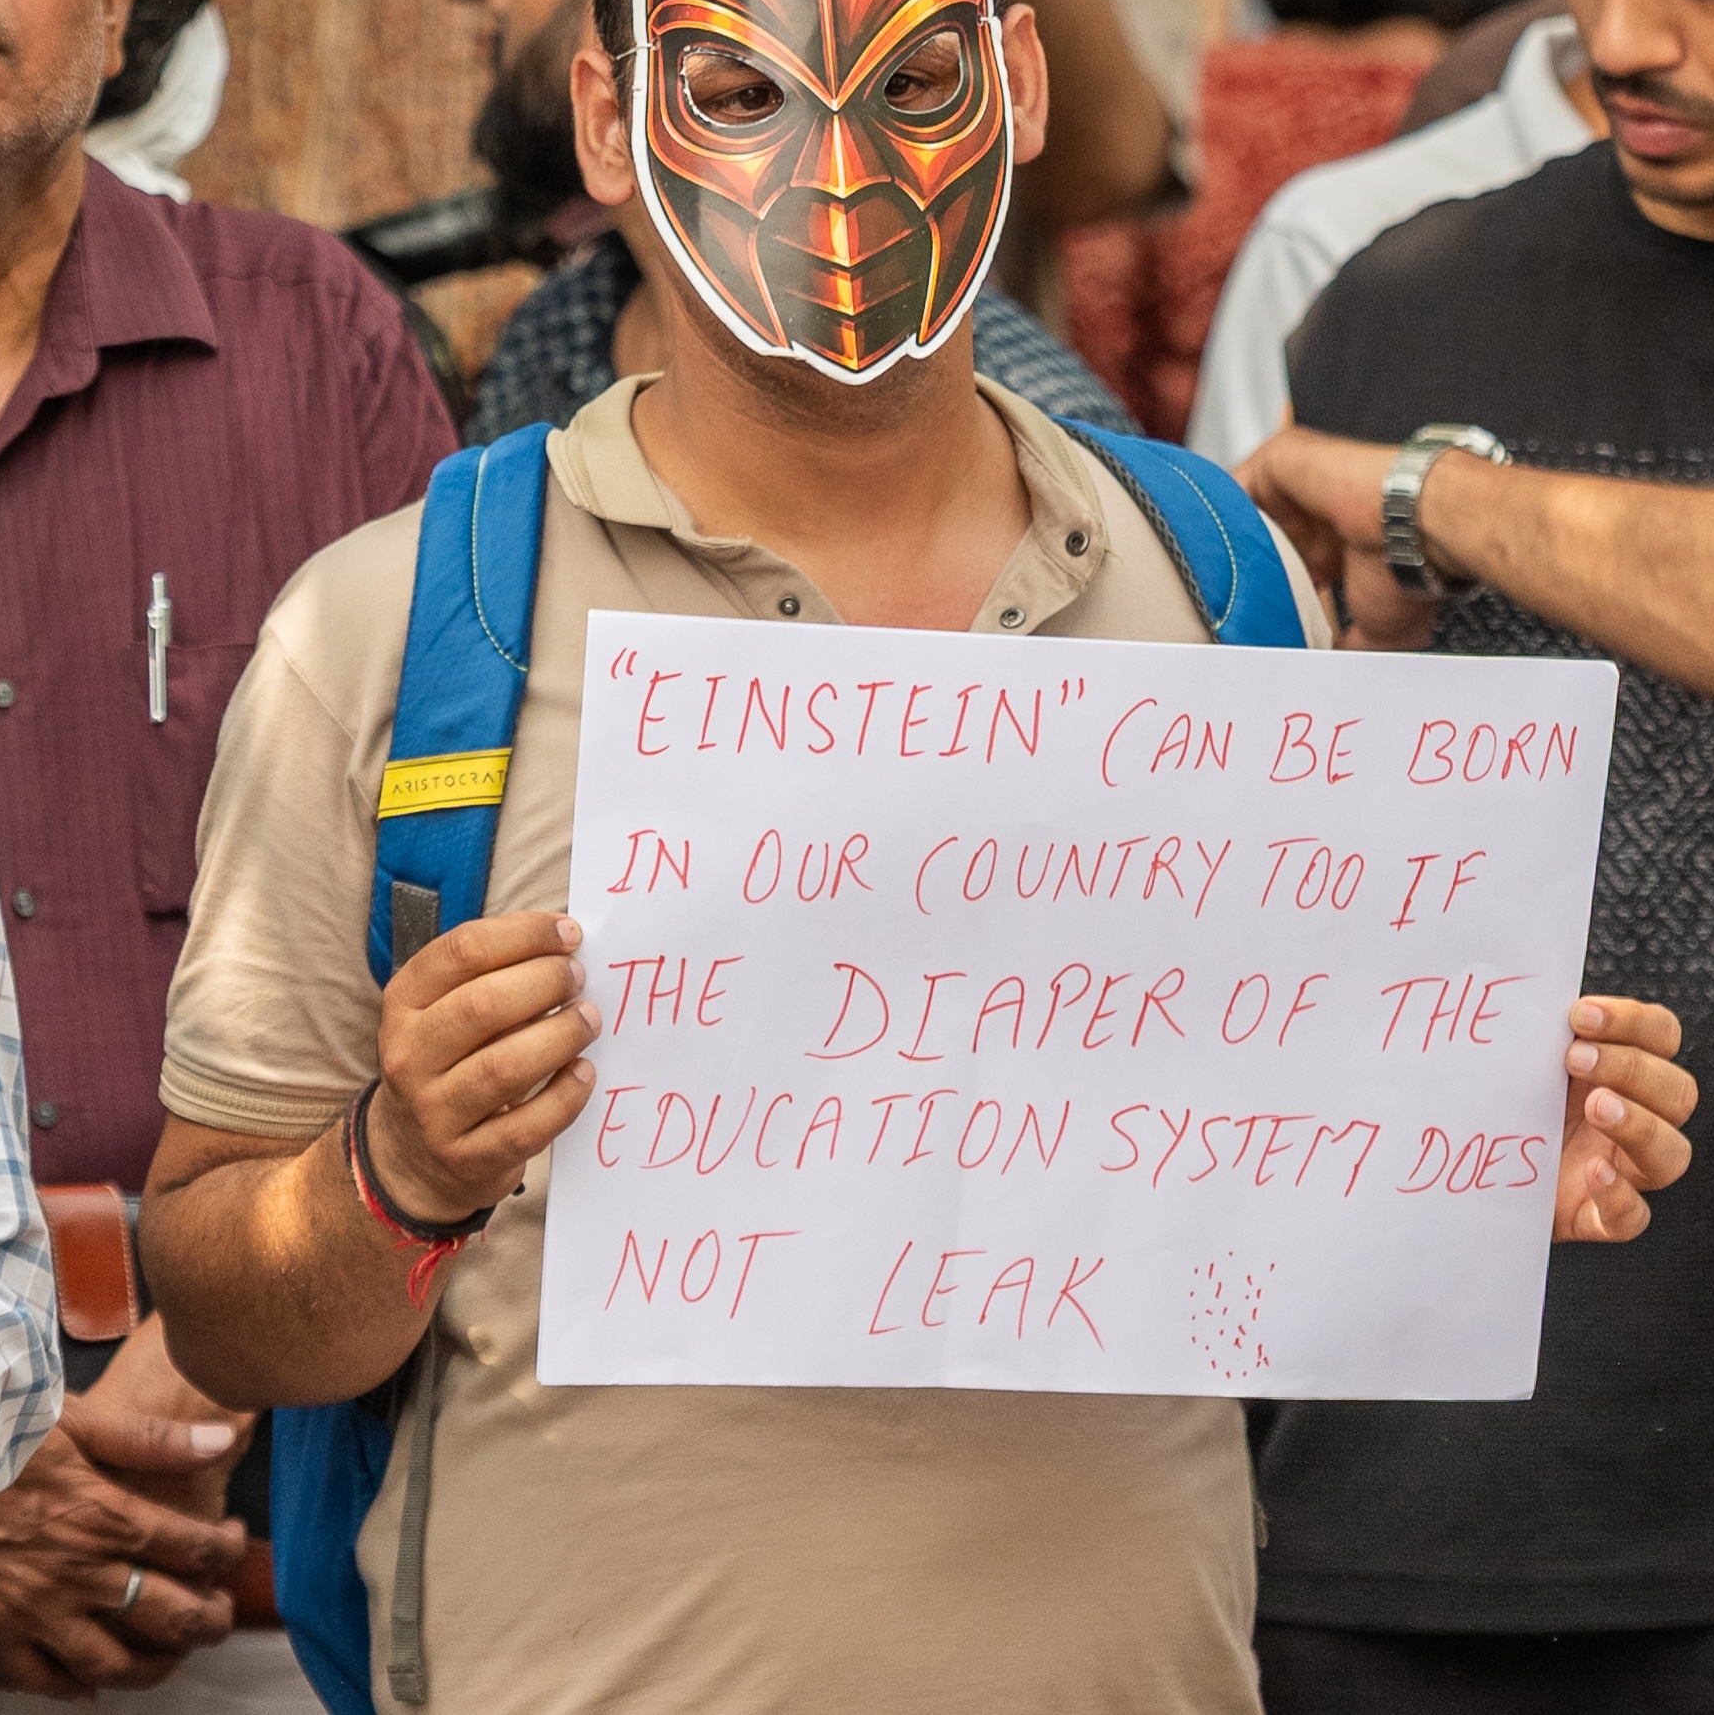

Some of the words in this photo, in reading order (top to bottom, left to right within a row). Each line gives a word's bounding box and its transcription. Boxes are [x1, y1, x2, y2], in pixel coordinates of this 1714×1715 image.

[392, 770, 505, 795] ARISTOCRAT
[1102, 699, 1233, 787] CAN
[1269, 712, 1366, 784] BE
[1407, 719, 1578, 784] BORN
[607, 829, 690, 893] IN
[742, 828, 874, 904] OUR
[916, 836, 1231, 916] COUNTRY
[1260, 837, 1365, 910] TOO
[1390, 851, 1487, 932] IF
[607, 955, 745, 1036] THE
[803, 963, 1186, 1062] DIAPER
[1221, 973, 1330, 1047] OF
[1380, 973, 1540, 1053] THE
[596, 1085, 1070, 1176] EDUCATION
[1100, 1104, 1381, 1197] SYSTEM
[1396, 1127, 1547, 1193] DOES
[604, 1229, 804, 1319] NOT
[869, 1240, 1105, 1352] LEAK
